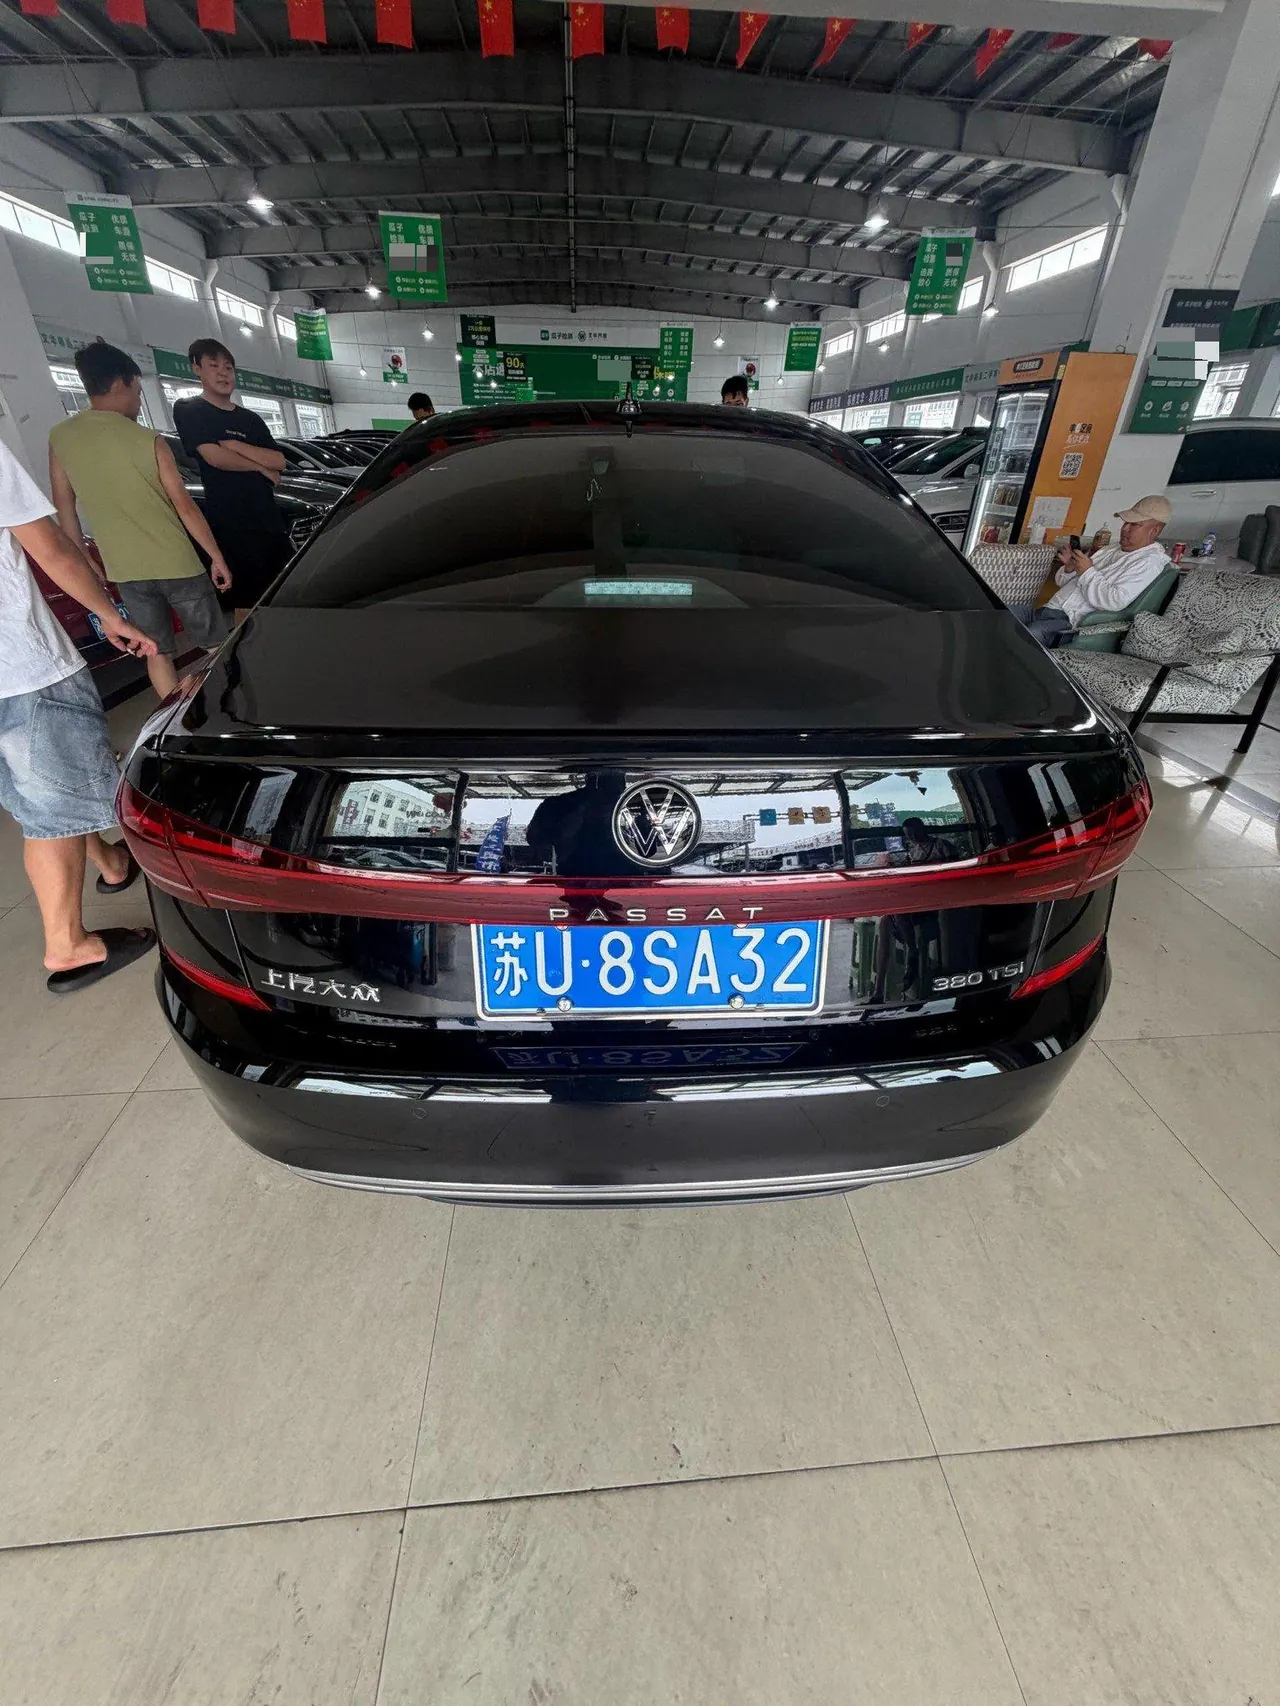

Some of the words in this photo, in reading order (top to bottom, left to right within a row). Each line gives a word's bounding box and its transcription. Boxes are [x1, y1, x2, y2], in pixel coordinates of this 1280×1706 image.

[549, 907, 763, 922] PASSAT
[491, 928, 811, 997] 苏U·8SA32
[932, 971, 983, 991] 380
[987, 961, 1024, 980] TSI
[261, 969, 380, 1002] 上汽大众
